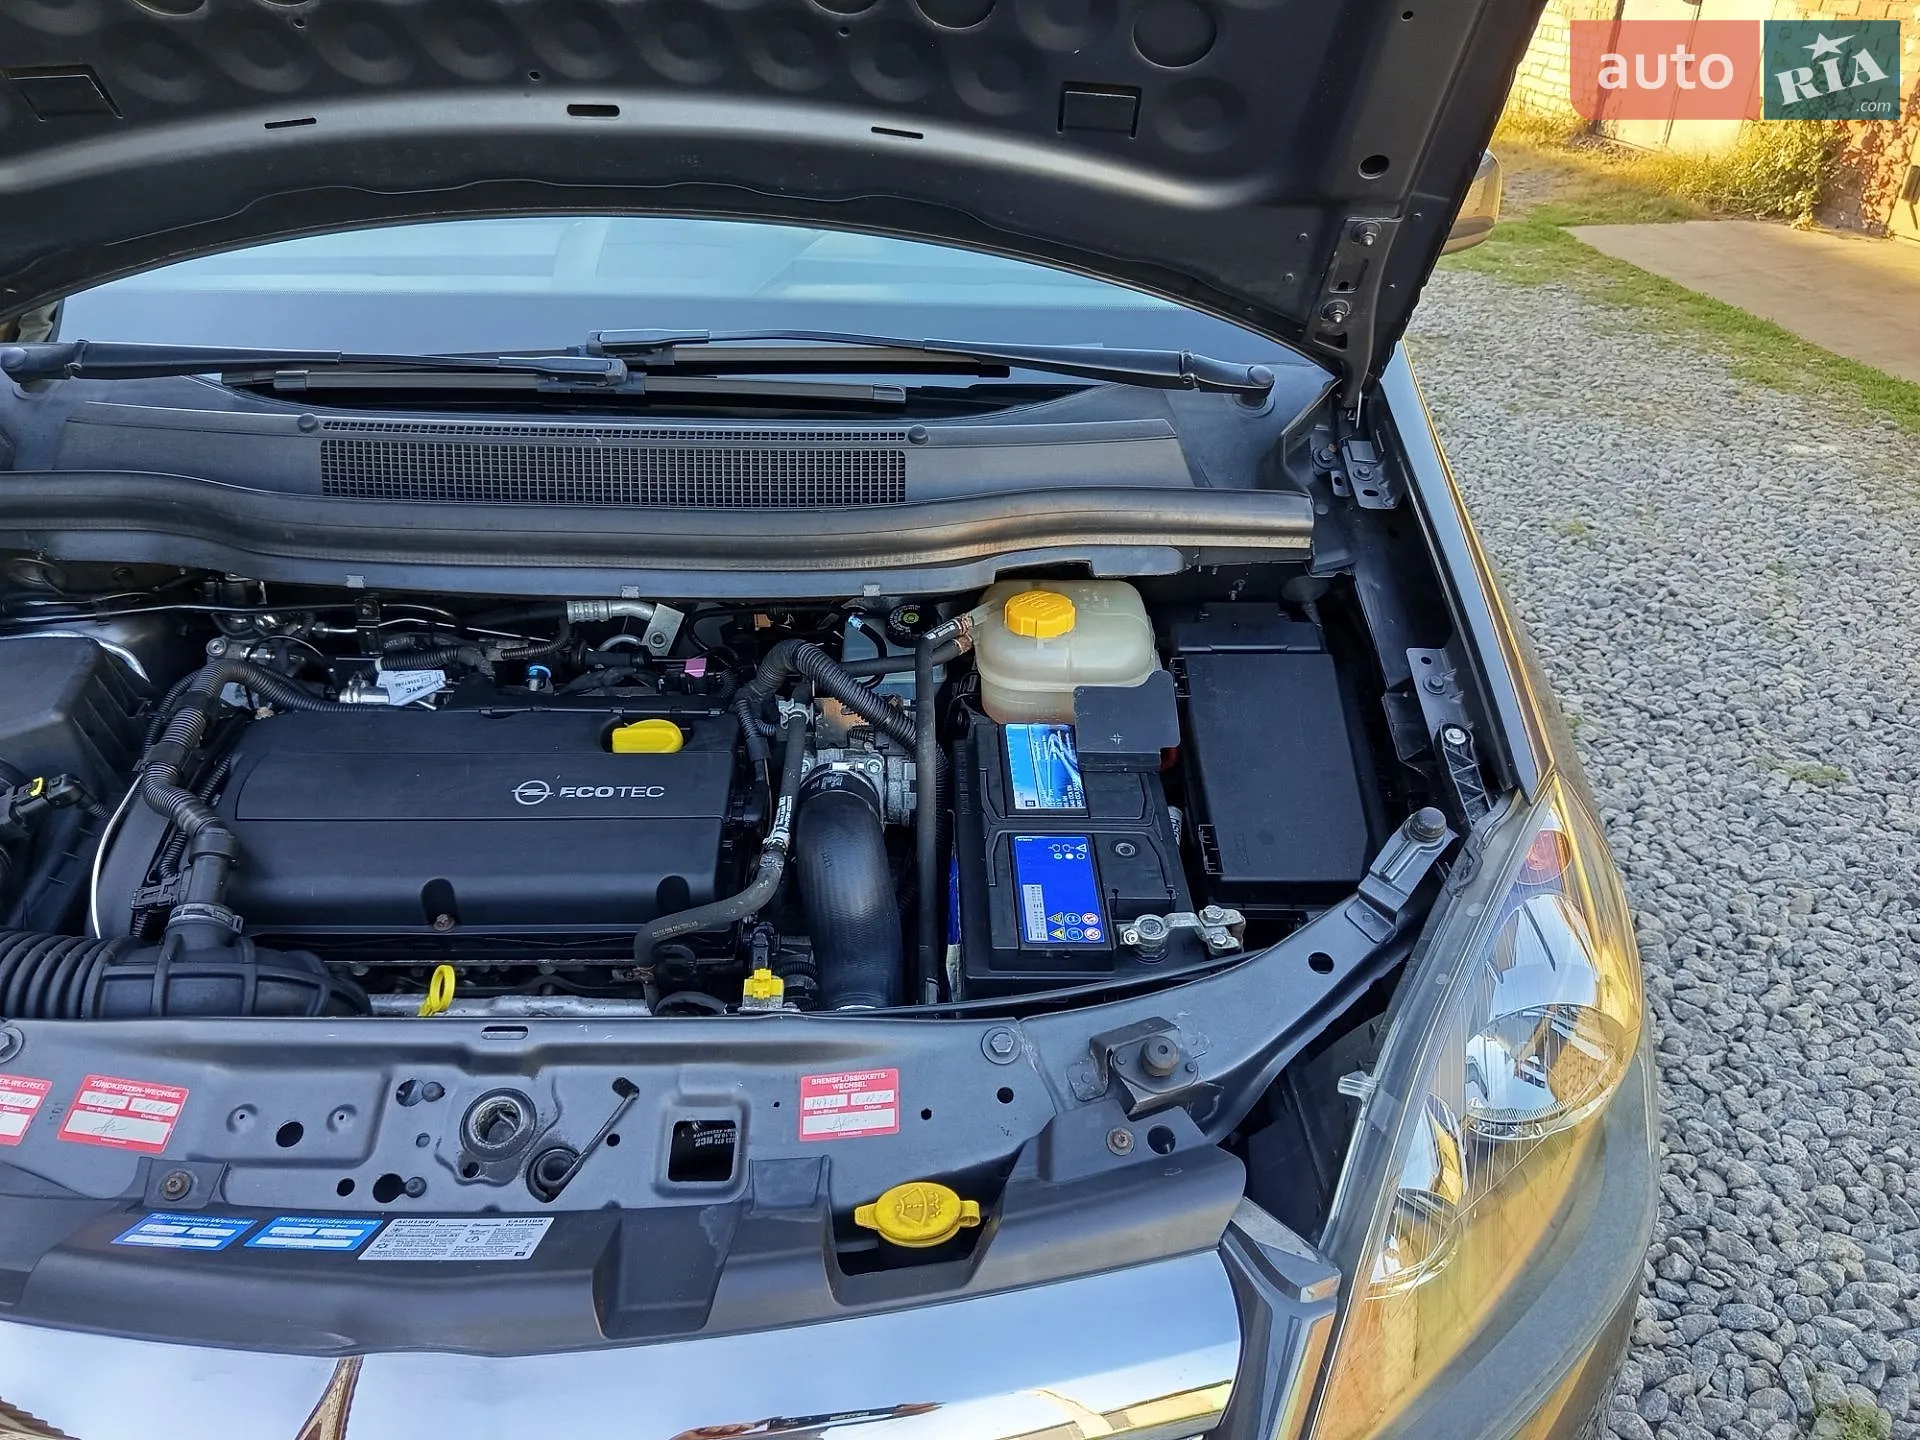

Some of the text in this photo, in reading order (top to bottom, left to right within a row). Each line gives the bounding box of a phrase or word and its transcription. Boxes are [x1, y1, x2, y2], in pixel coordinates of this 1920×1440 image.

[560, 786, 665, 798] ECOTEC
[811, 1072, 888, 1085] BREMSFLÜSSIGKEITS-
[90, 1079, 182, 1099] ZÜNDKERZEN-WECHSEL
[831, 1081, 868, 1090] WECHSEL
